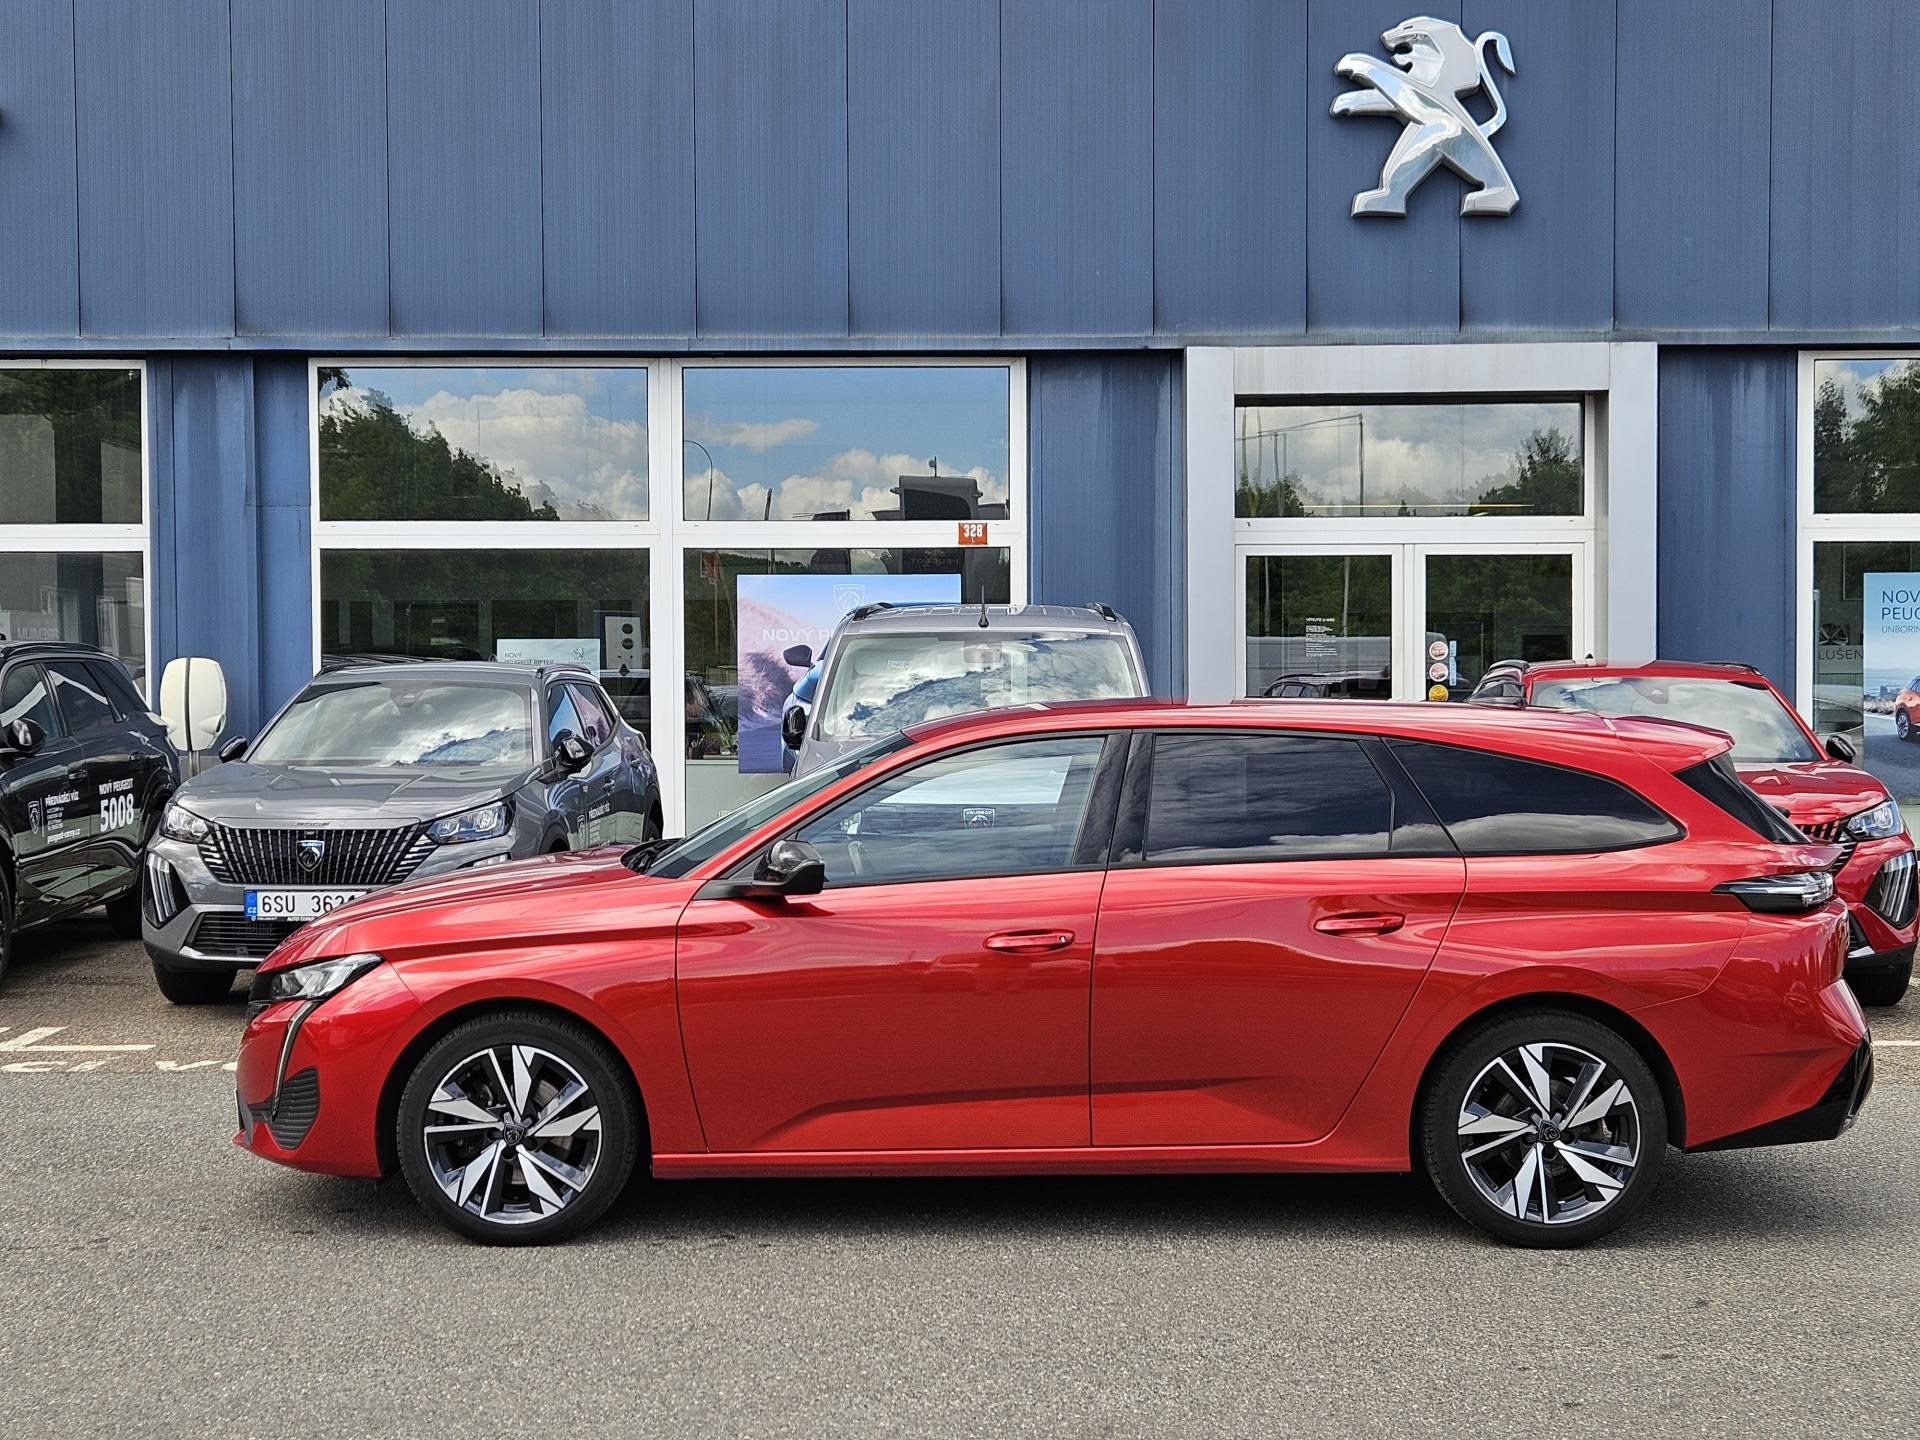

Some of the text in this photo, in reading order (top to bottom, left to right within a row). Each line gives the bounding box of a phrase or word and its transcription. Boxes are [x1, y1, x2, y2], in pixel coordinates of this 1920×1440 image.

[963, 524, 983, 537] 328
[762, 625, 813, 641] NOVÝ
[99, 778, 133, 795] NOVÝ PEUGEOT
[100, 793, 134, 832] 5008
[247, 906, 257, 914] CZ
[262, 895, 295, 913] 6SU
